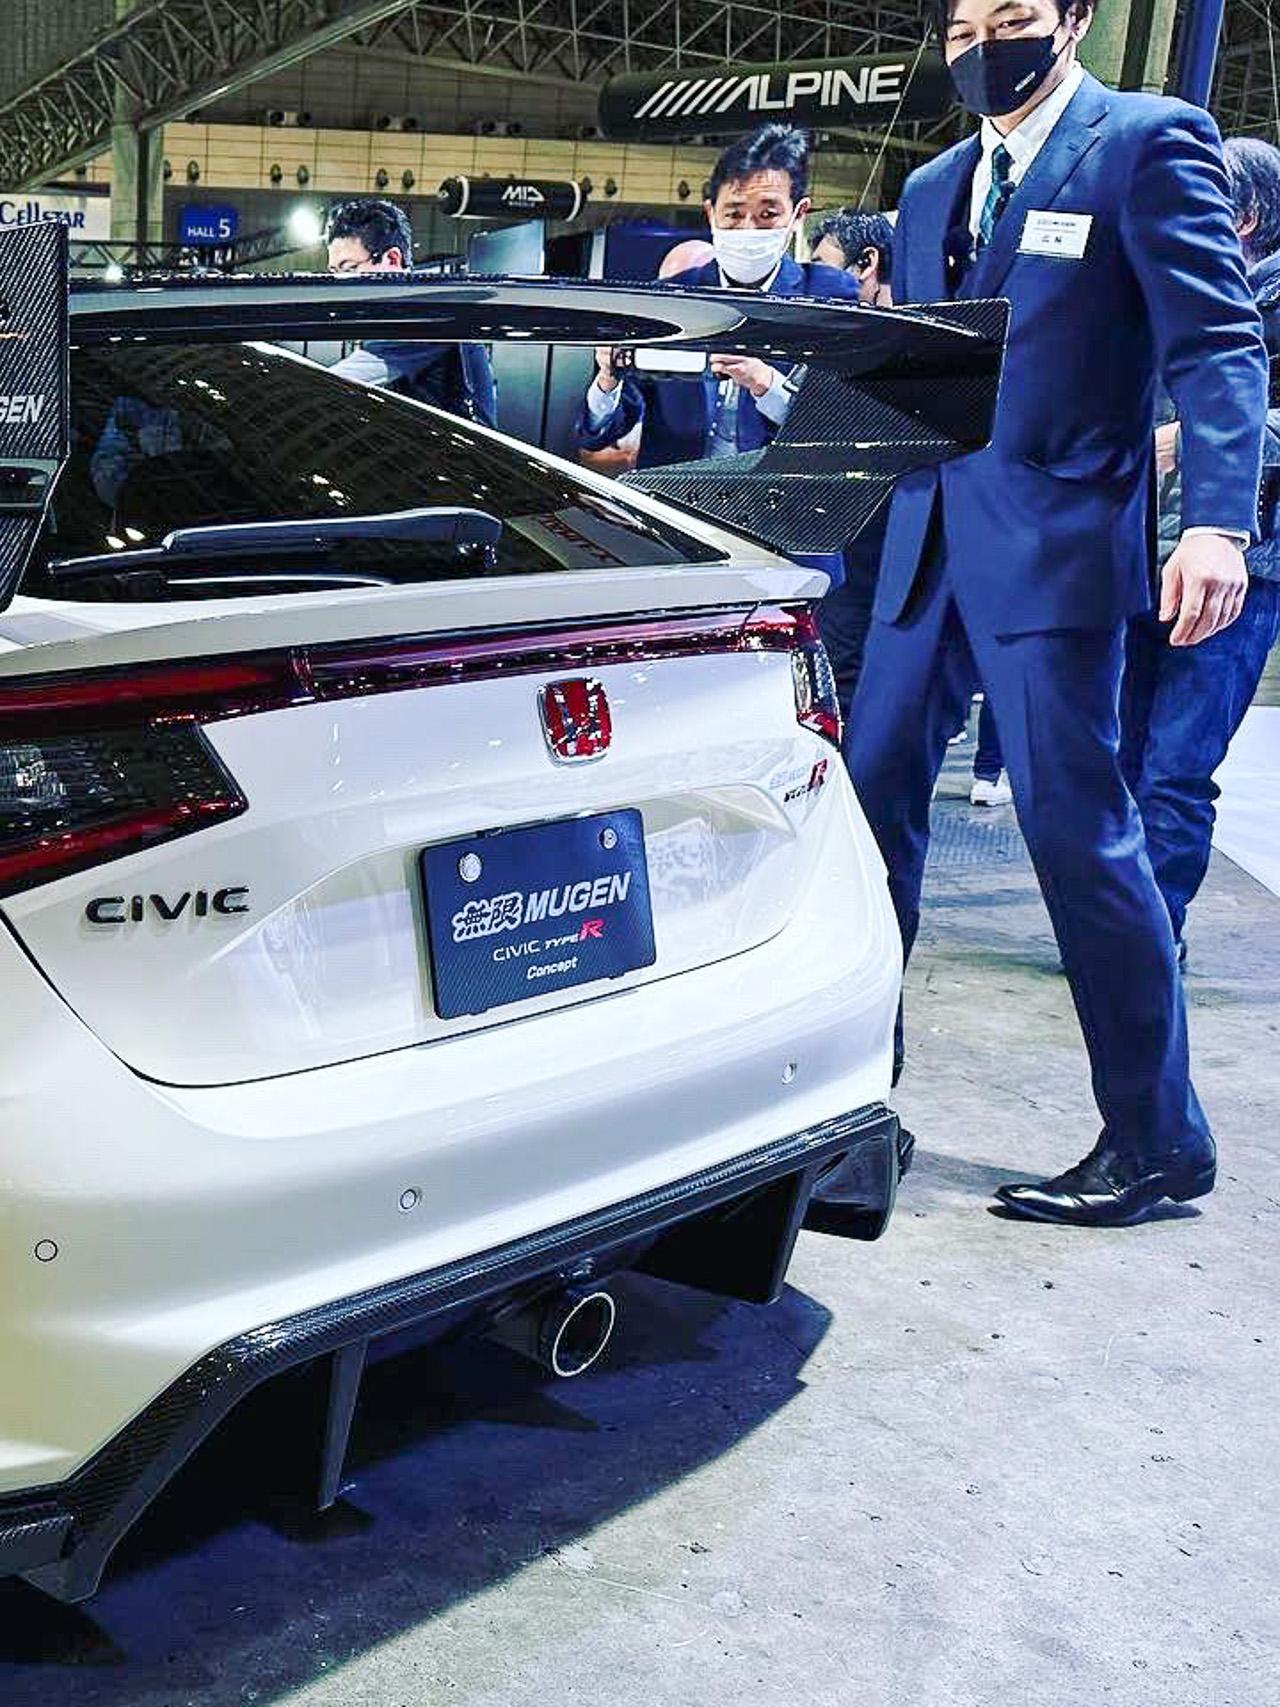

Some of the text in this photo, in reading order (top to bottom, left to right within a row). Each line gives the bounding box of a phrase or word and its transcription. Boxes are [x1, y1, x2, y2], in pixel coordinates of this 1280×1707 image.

[715, 64, 906, 113] ALPINE
[187, 218, 231, 238] HALL 5
[85, 885, 250, 924] CIVIC
[523, 871, 632, 924] MUGEN
[493, 940, 542, 962] CIVIC
[579, 918, 605, 941] R
[526, 956, 579, 980] Concept
